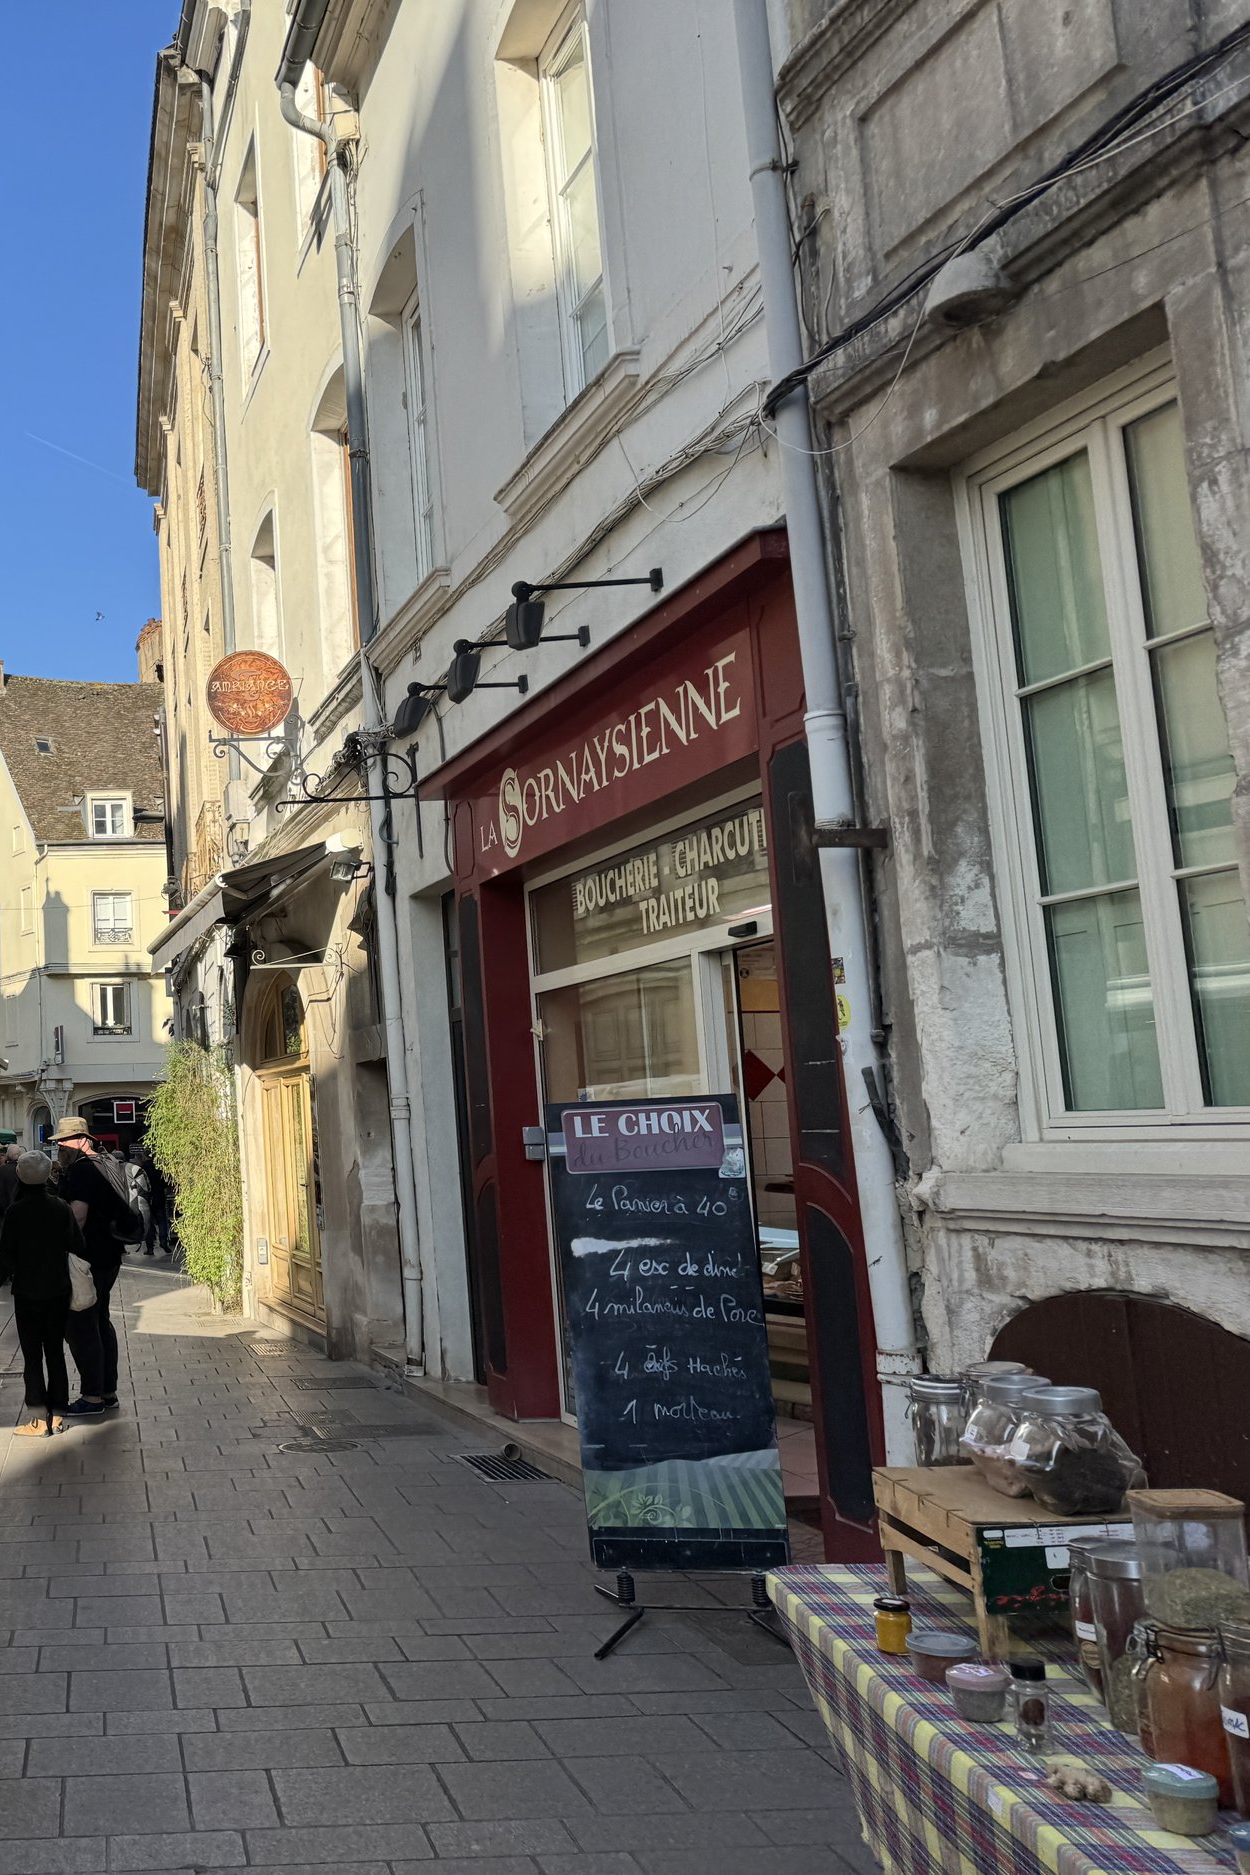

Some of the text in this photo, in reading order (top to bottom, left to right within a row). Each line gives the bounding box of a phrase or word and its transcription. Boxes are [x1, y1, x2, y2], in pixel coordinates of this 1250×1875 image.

[210, 679, 290, 693] AMBIANCE
[480, 651, 741, 858] LA SORNAYSIENNE
[575, 852, 660, 914] BOUCHERIE
[638, 877, 721, 934] TRAITEUR
[573, 1109, 714, 1138] LE CHOIX
[574, 1122, 714, 1168] du Boucher
[586, 1183, 605, 1210] Le
[610, 1249, 631, 1282] 4
[638, 1258, 670, 1277] esc
[678, 1251, 699, 1276] de
[586, 1288, 599, 1321] 4
[692, 1294, 716, 1319] de
[614, 1351, 629, 1380] 4
[619, 1399, 637, 1424] 1
